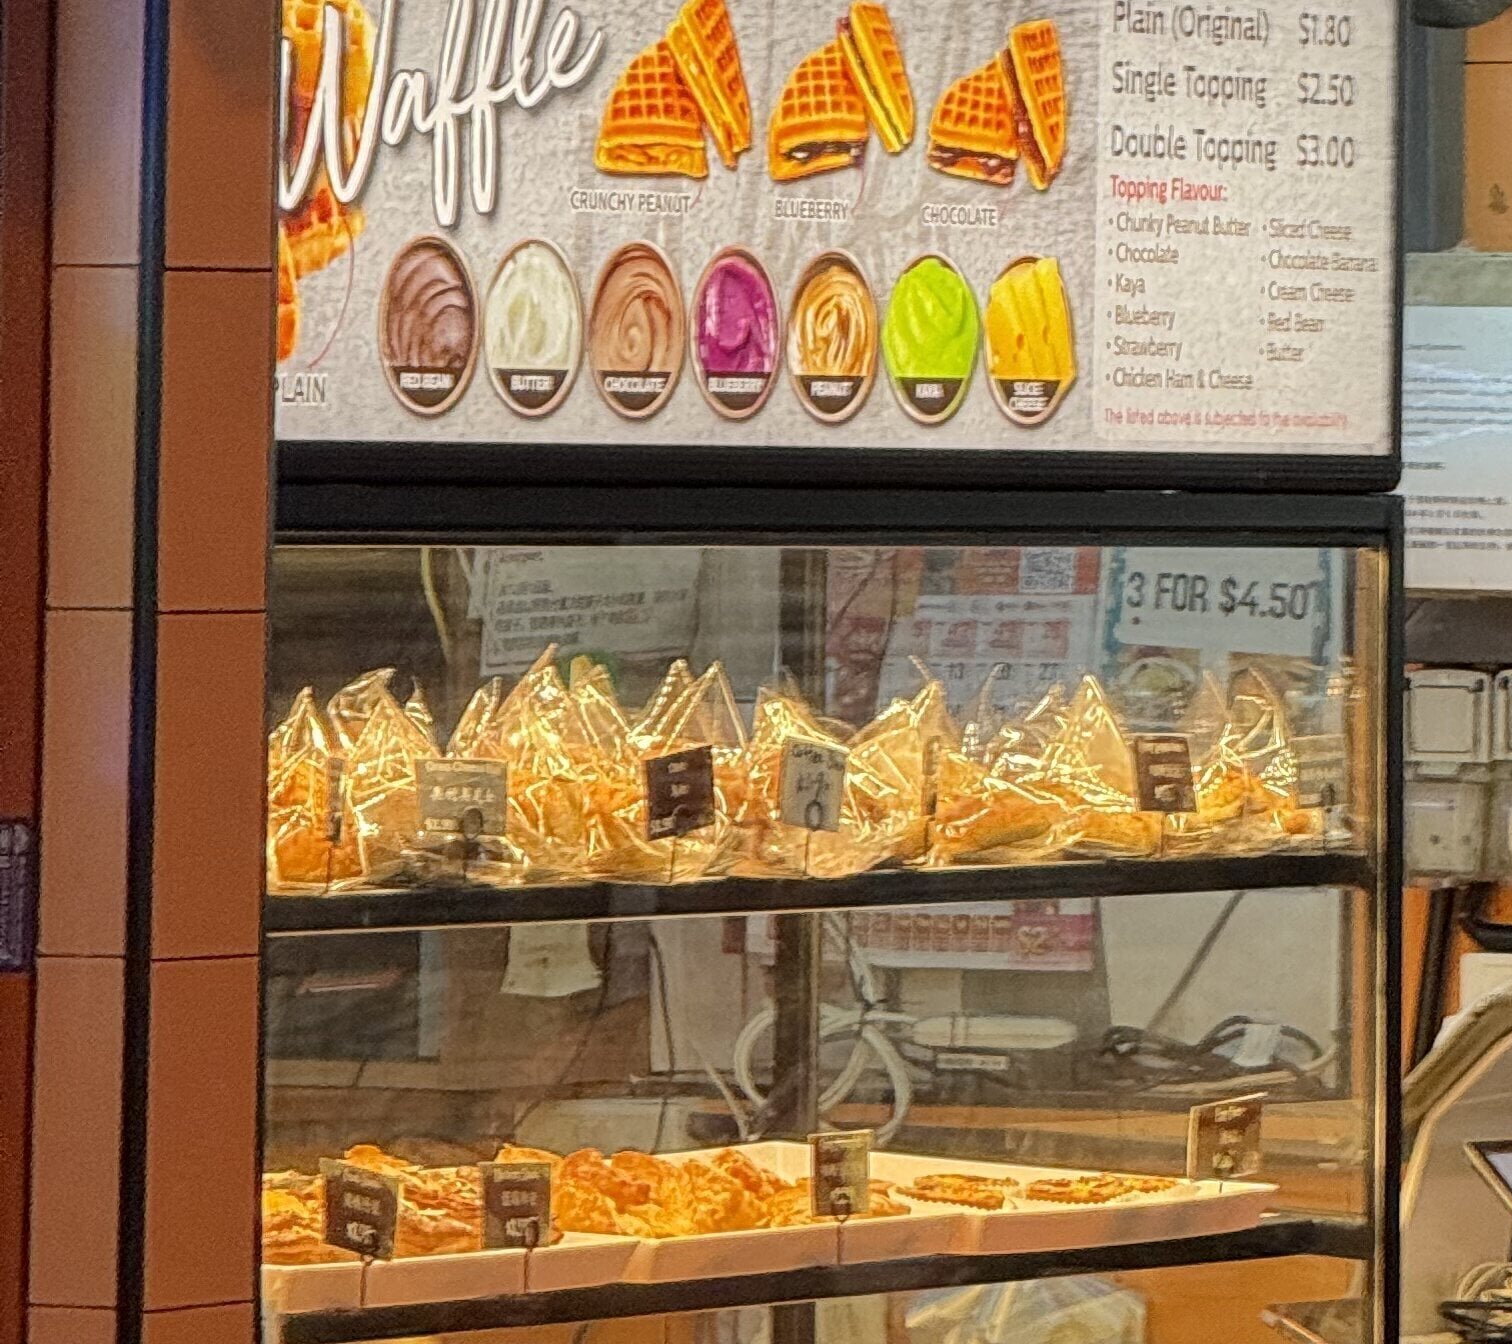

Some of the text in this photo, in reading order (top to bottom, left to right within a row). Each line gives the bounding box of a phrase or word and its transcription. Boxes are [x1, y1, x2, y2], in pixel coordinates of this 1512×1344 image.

[1112, 0, 1352, 48] Plain (Original) $1.80
[1111, 61, 1354, 109] Single Topping $2.50
[1110, 124, 1355, 172] Double Topping $3.00
[570, 189, 691, 215] CRUNCHY PEANUT
[1110, 175, 1228, 205] Topping Flavour:
[775, 198, 849, 221] BLUEBERRY
[921, 205, 997, 226] CHOCOLATE
[1116, 212, 1164, 238] Chunky
[1167, 214, 1210, 235] Peanut
[1116, 243, 1180, 265] Chocolate
[1115, 273, 1146, 297] Kaya
[1114, 305, 1176, 331] Blueberry
[1113, 336, 1183, 361] Strawberry
[1112, 367, 1162, 389] Chicken
[1126, 571, 1309, 622] 3 FOR $4.50
